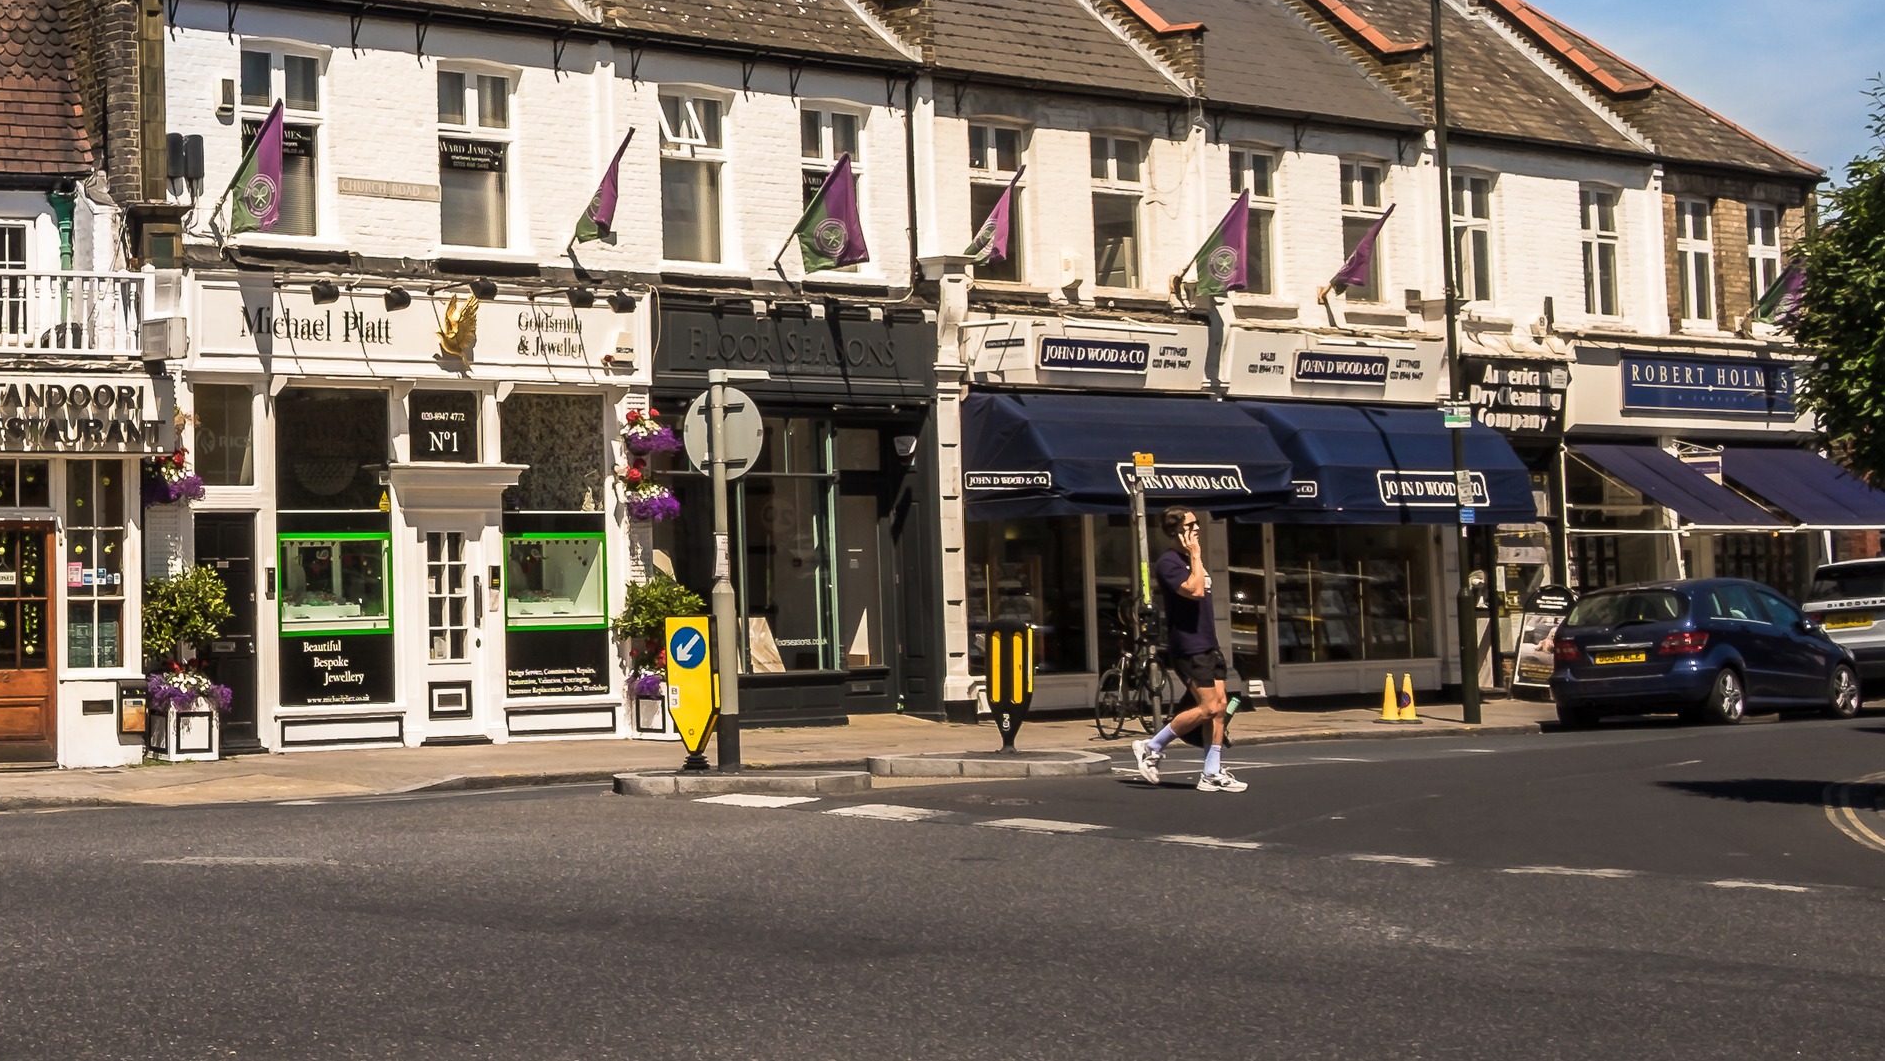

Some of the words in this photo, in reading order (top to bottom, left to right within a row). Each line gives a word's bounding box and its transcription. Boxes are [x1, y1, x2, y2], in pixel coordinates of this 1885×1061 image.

[439, 141, 465, 153] WARD
[468, 144, 494, 155] JAMES
[341, 179, 386, 194] CHURCH
[392, 183, 421, 197] ROAD
[240, 306, 332, 342] Michael
[342, 310, 393, 345] Platt
[517, 311, 583, 334] Goldsmith
[517, 335, 530, 355] &
[532, 336, 585, 359] Jeweller
[688, 327, 776, 363] FLOOR
[785, 331, 895, 367] SEASONS
[1043, 344, 1075, 362] JOHN
[1077, 347, 1085, 360] D
[1087, 347, 1119, 362] WOOD
[1120, 350, 1128, 363] &
[1159, 346, 1188, 357] LETTINGS
[1298, 359, 1326, 375] JOHN
[1326, 361, 1334, 373] D
[1336, 361, 1363, 374] WOOD
[1363, 363, 1371, 374] &
[1483, 364, 1552, 386] American
[1631, 364, 1704, 384] ROBERT
[1717, 368, 1788, 389] HOLMES
[1470, 384, 1497, 408] Dry
[1497, 386, 1563, 411] Cleaning
[1478, 408, 1549, 432] Company
[969, 476, 992, 485] JOHN
[993, 476, 1000, 484] D
[1001, 476, 1025, 485] WOOD
[1025, 477, 1032, 485] &
[1165, 475, 1175, 490] D
[1173, 476, 1210, 490] WOOD
[1211, 477, 1220, 490] &
[1416, 481, 1424, 496] D
[1424, 482, 1456, 496] WOOD
[303, 639, 342, 653] Beautiful
[313, 656, 349, 671] Bespoke
[322, 670, 365, 687] Jewellery
[671, 687, 678, 695] B
